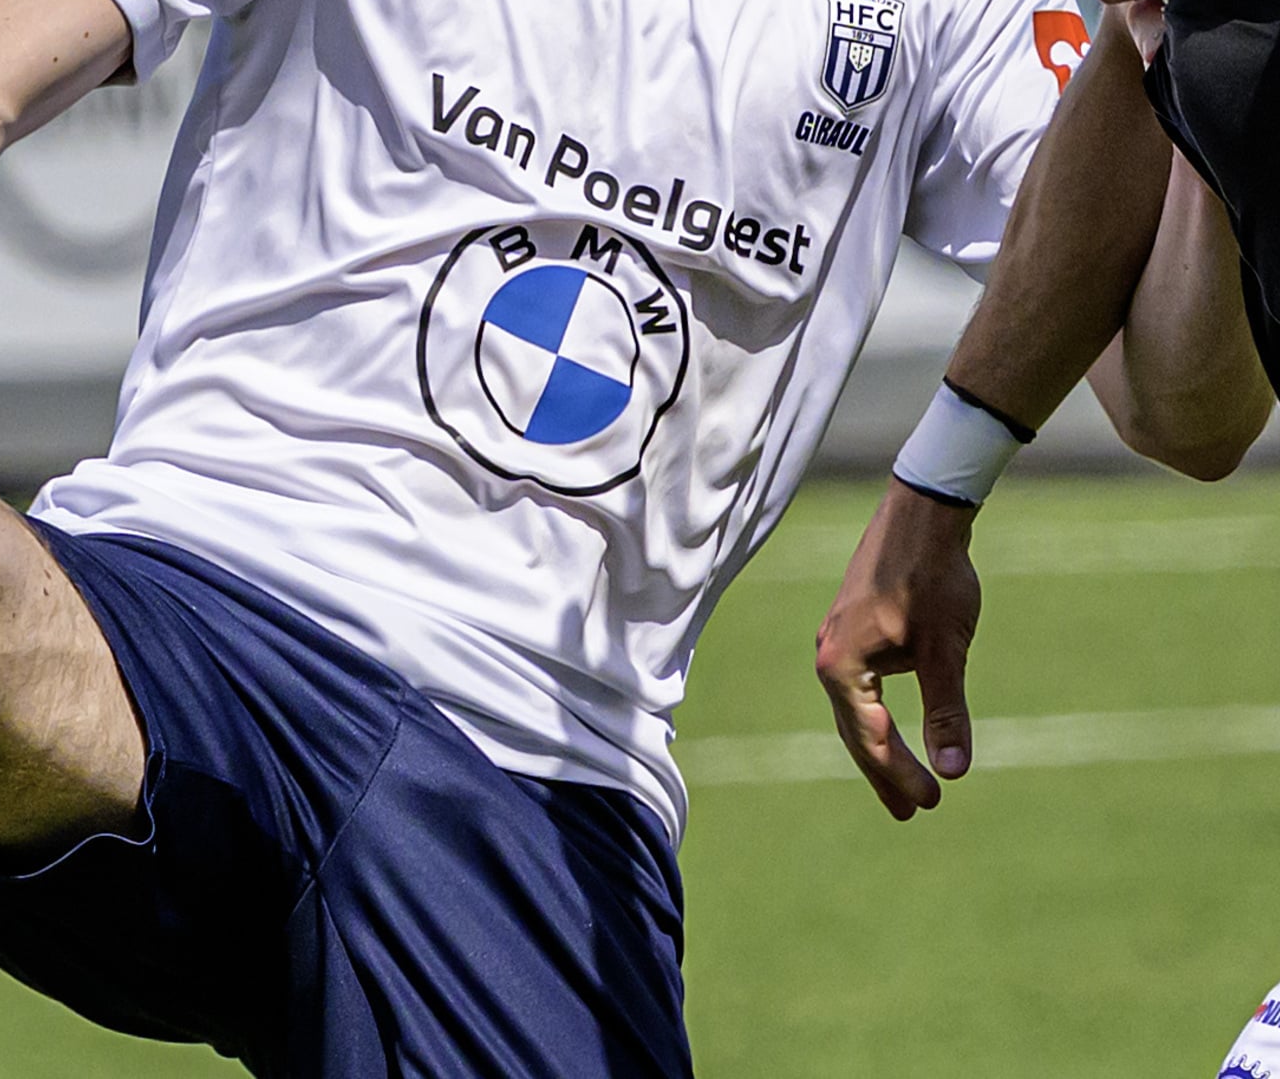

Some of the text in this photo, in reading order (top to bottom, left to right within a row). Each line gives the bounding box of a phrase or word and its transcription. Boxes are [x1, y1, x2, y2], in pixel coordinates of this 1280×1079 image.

[837, 1, 894, 31] HFC
[852, 29, 875, 43] 1879
[431, 73, 536, 170] Van
[795, 111, 873, 156] GIRAUL
[488, 223, 677, 336] BMW
